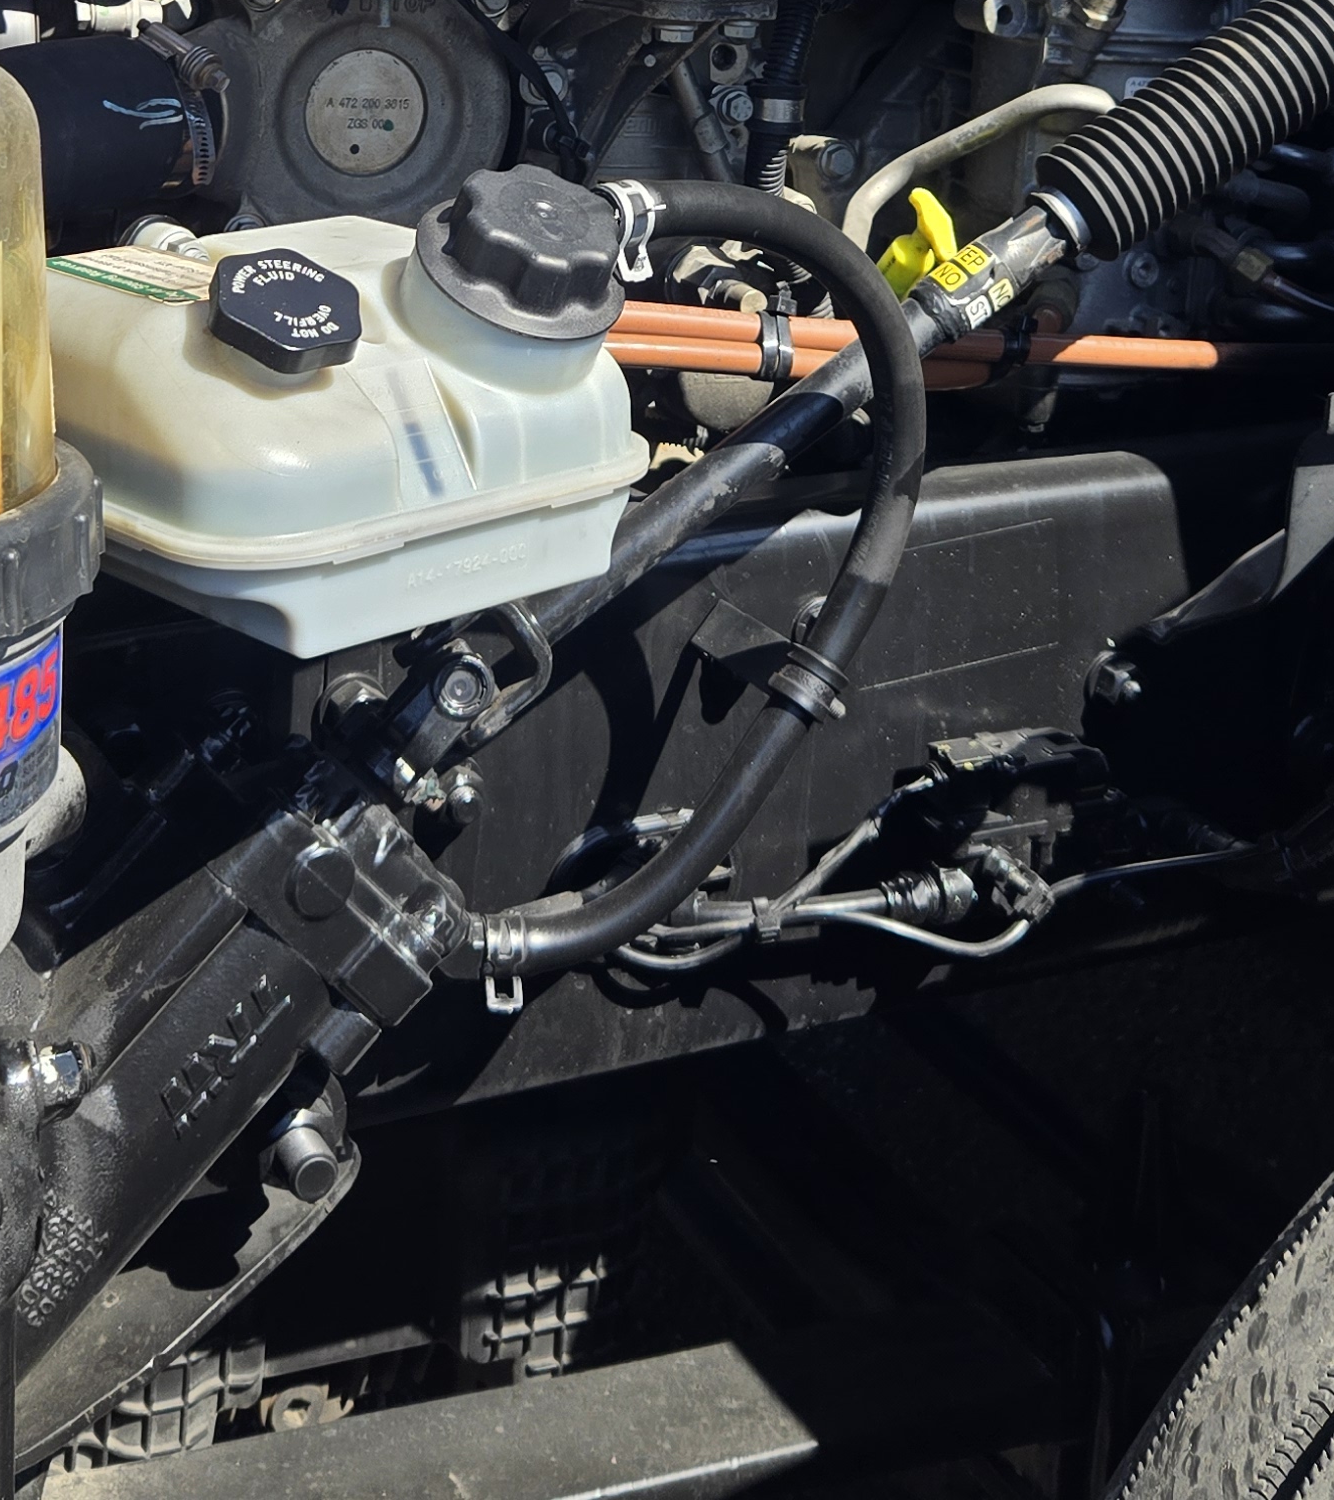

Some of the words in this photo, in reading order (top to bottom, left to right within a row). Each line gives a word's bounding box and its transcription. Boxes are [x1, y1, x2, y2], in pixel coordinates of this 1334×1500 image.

[326, 98, 334, 108] A
[338, 97, 358, 109] 472
[362, 98, 381, 109] 200
[347, 118, 368, 129] ZGS
[231, 265, 256, 294] POWER
[257, 260, 325, 282] STEERING
[252, 271, 295, 286] FLUID
[935, 264, 961, 285] NO
[273, 304, 332, 328] OVERFILL
[291, 328, 319, 338] NOT
[321, 322, 340, 335] DO
